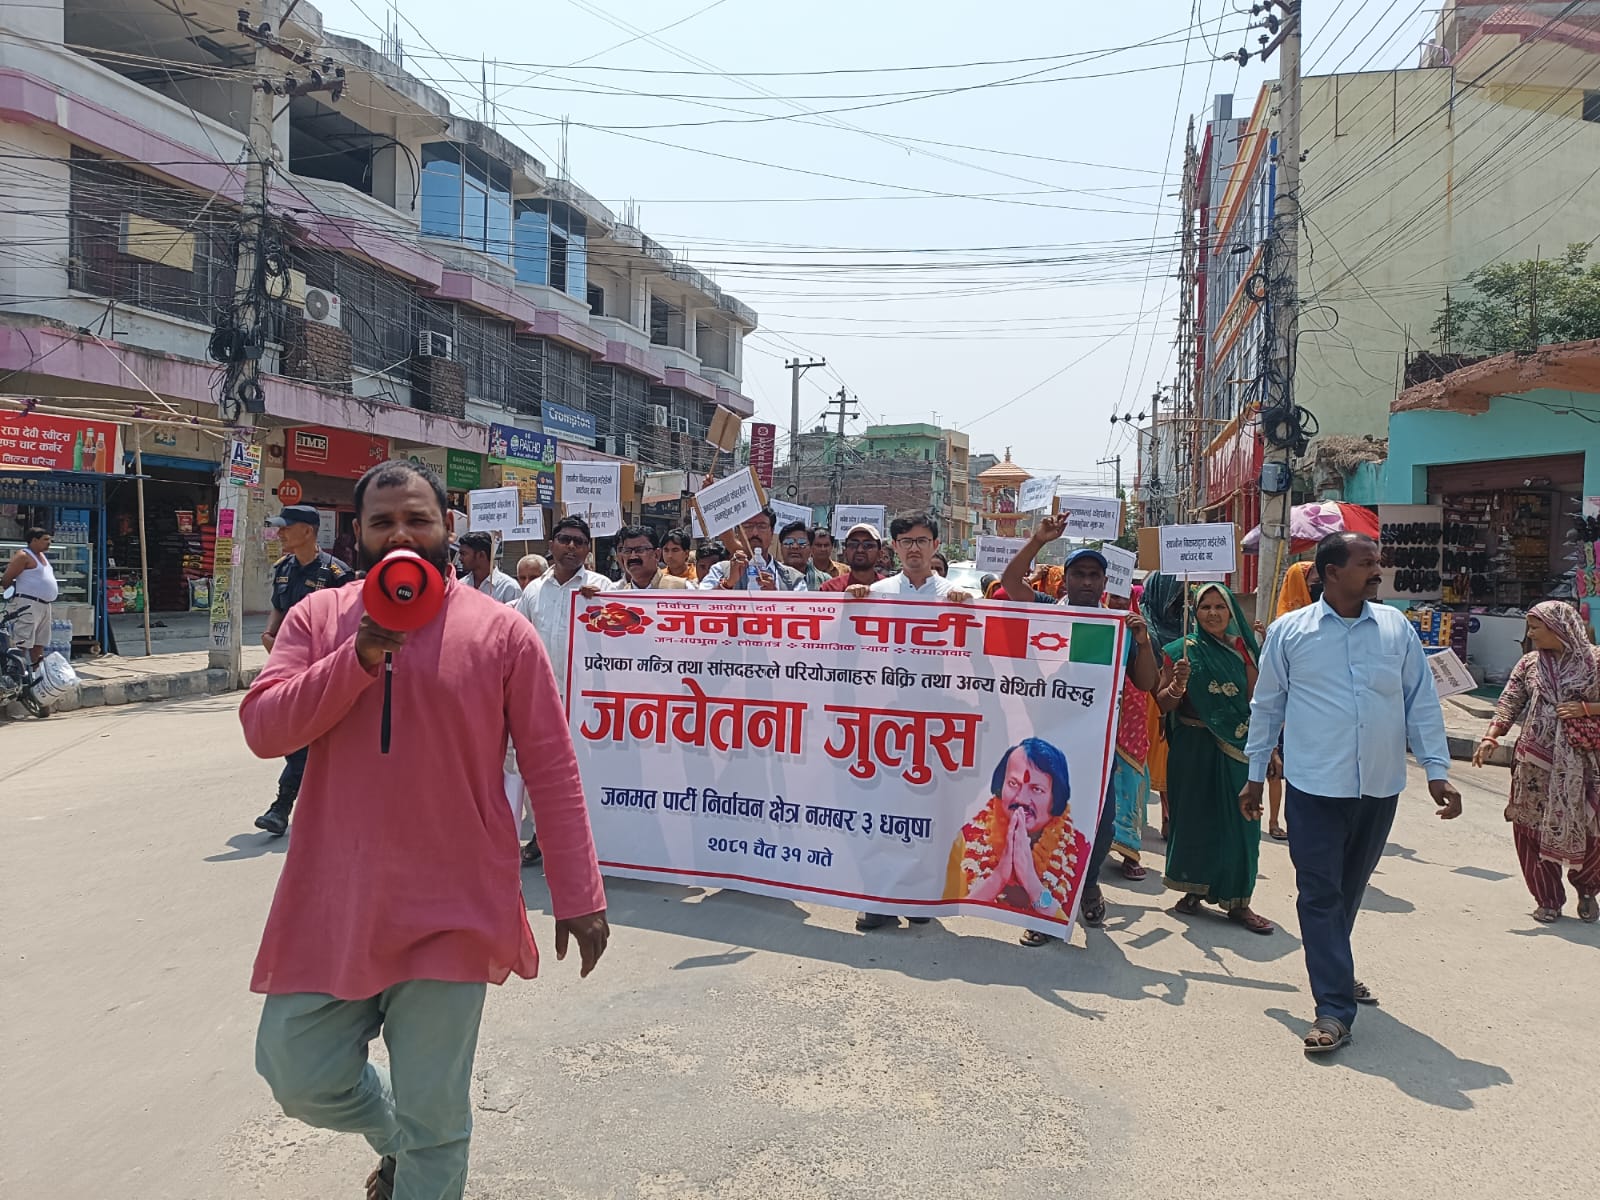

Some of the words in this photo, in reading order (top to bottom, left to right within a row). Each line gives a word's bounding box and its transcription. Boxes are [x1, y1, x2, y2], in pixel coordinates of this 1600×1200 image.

[548, 407, 591, 429] Crompton
[1, 426, 20, 436] राज
[22, 426, 39, 438] देवी
[280, 482, 297, 496] ria
[656, 602, 699, 610] निर्वाचन
[708, 604, 747, 612] आयोग
[756, 604, 776, 612] दर्ता
[656, 610, 834, 641] जनमत
[849, 613, 983, 648] पार्टी
[801, 642, 856, 651] सामाजिक
[910, 648, 972, 657] समाजवाद
[584, 653, 633, 672] प्रदेशका
[678, 660, 703, 674] तथा
[882, 666, 917, 688] बिक्रि
[922, 674, 952, 689] तथा
[957, 675, 995, 693] अन्य
[1000, 675, 1047, 698] बेथिती
[580, 678, 808, 754] जनचेतना
[824, 704, 983, 784] जुलुस
[601, 786, 658, 810] जनमत
[663, 787, 698, 812] पार्टी
[702, 788, 764, 818] निर्वाचन
[769, 795, 800, 823] क्षेत्र
[861, 812, 873, 834] ३
[880, 814, 932, 843] धनुषा
[707, 837, 747, 854] २०८१
[754, 838, 777, 859] चैत
[781, 846, 802, 862] ३१
[808, 847, 833, 867] गते
